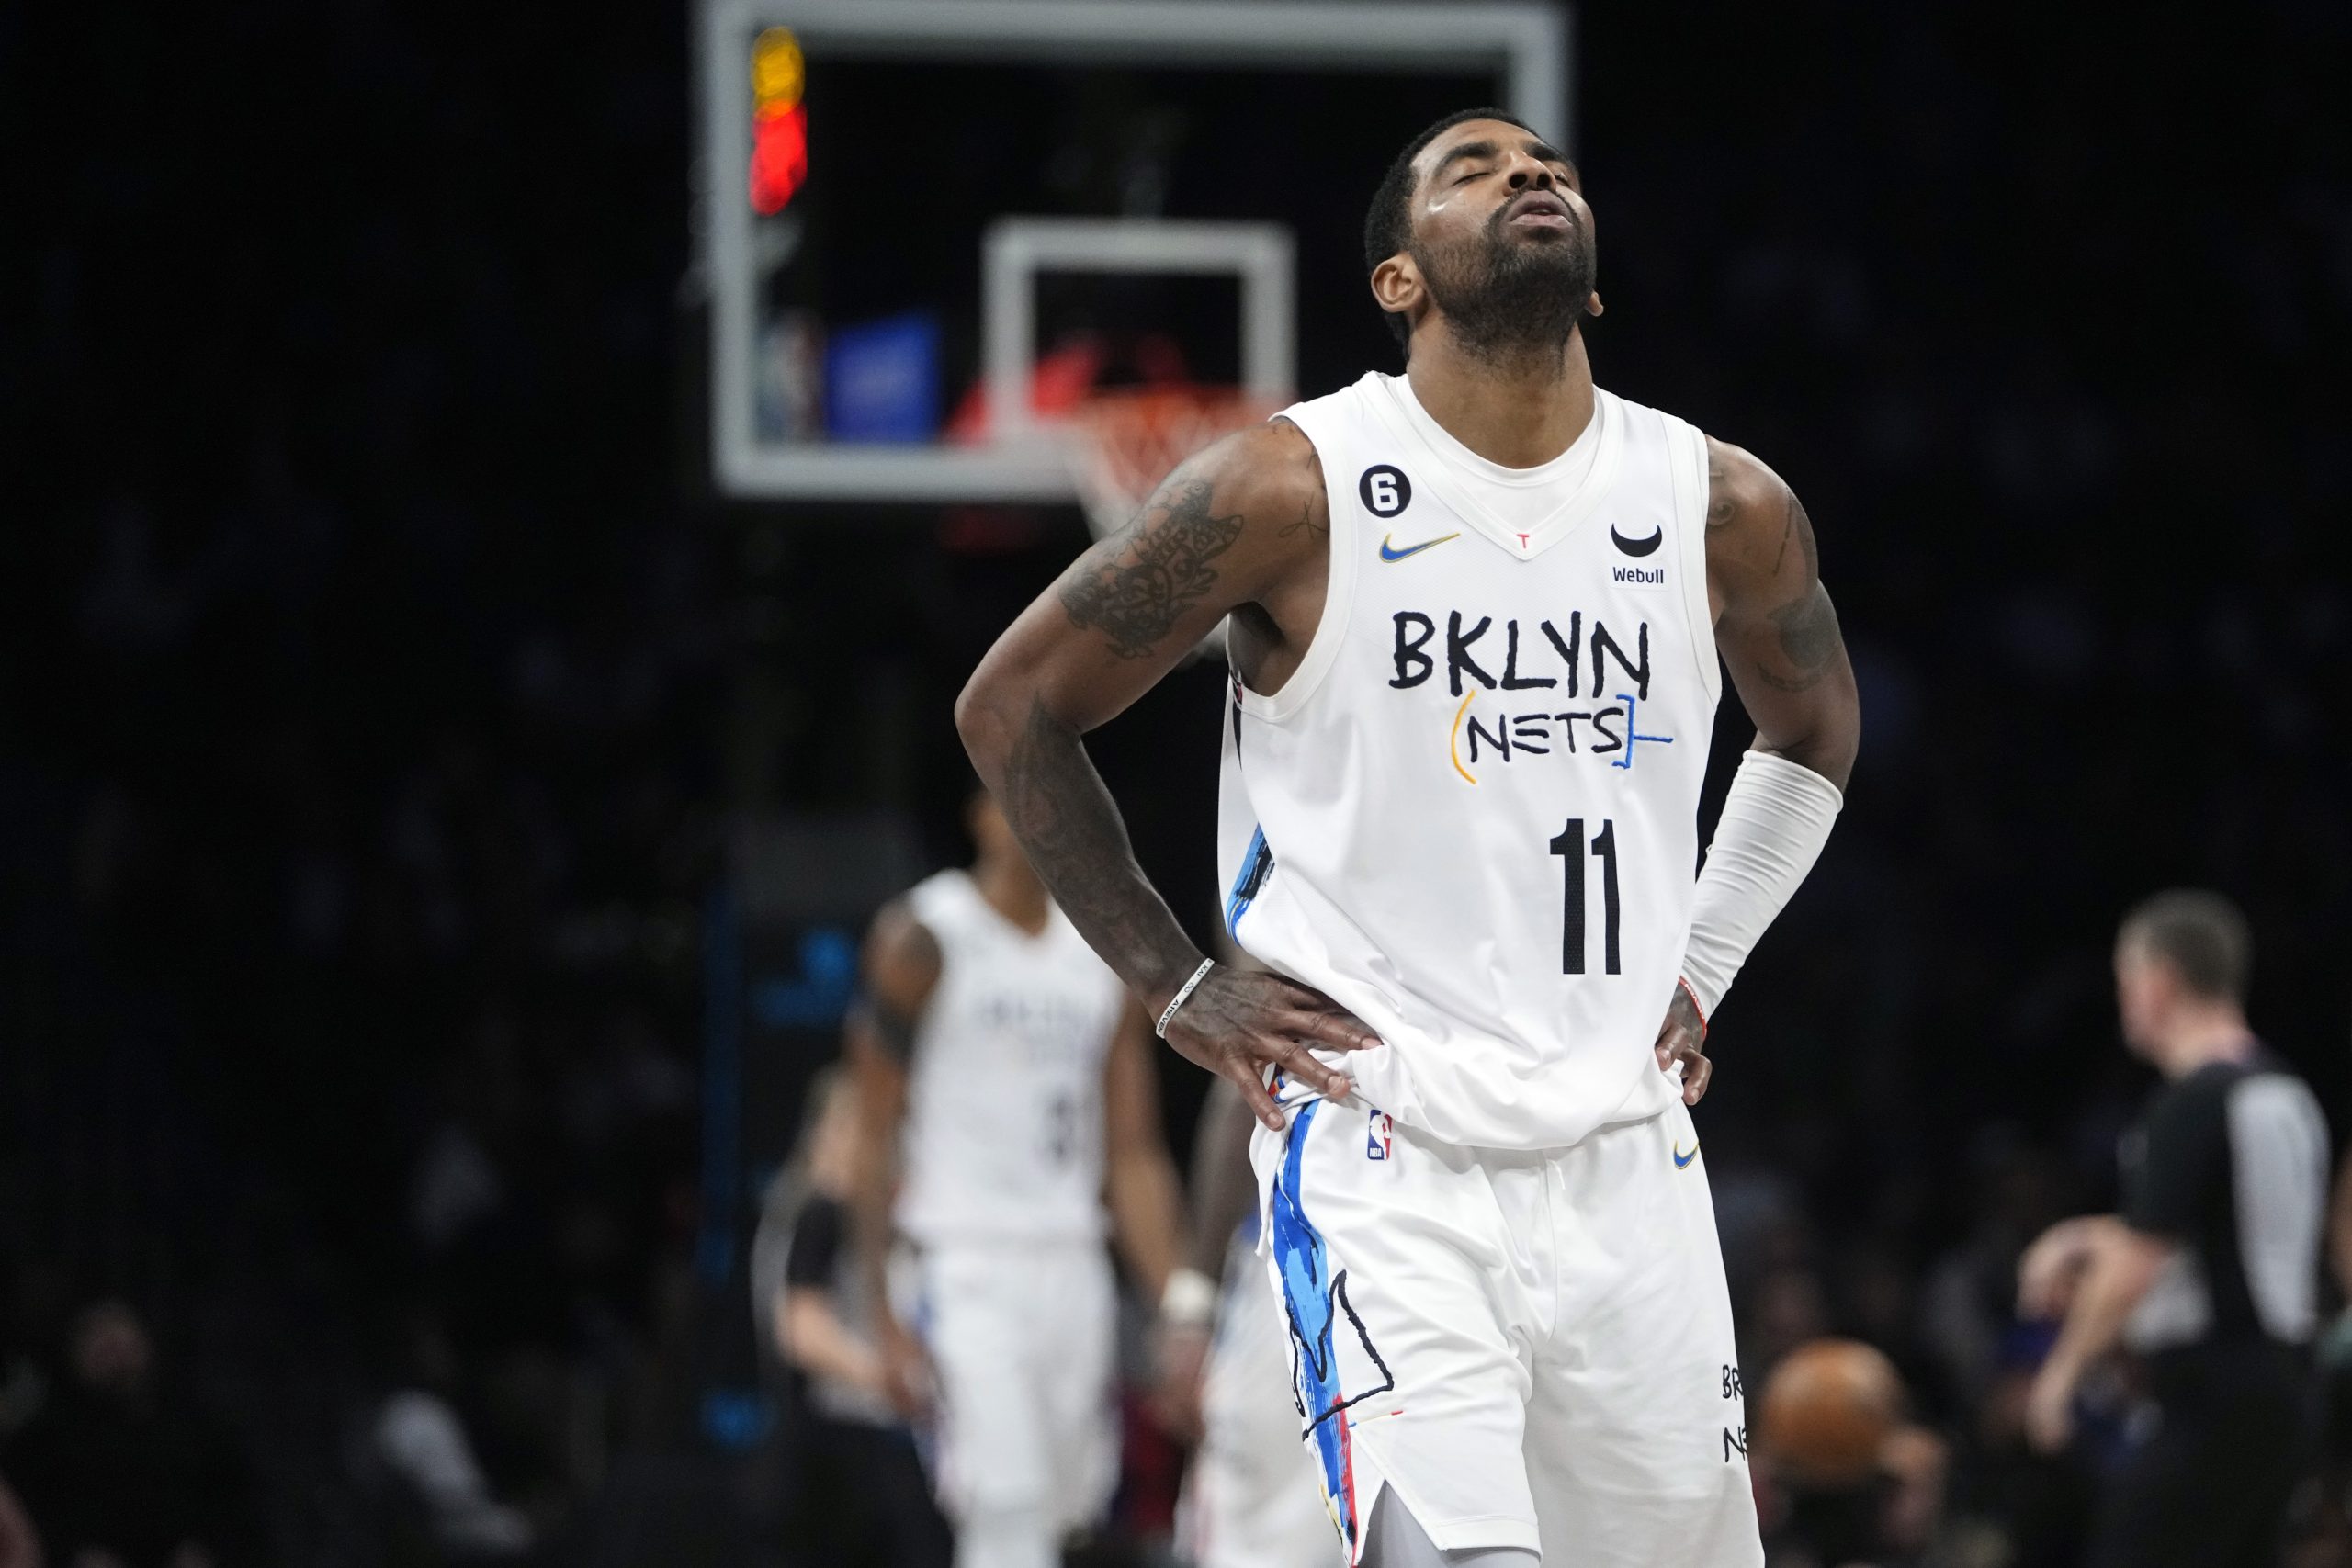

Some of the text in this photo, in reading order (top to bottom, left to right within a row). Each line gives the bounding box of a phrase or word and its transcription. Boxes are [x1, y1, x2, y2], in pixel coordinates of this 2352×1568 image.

[1370, 472, 1399, 512] 6
[1517, 534, 1529, 548] T
[1612, 567, 1665, 584] Webull
[1388, 610, 1651, 701] BKLYN
[1550, 818, 1622, 975] 11
[1369, 1147, 1382, 1157] NBA
